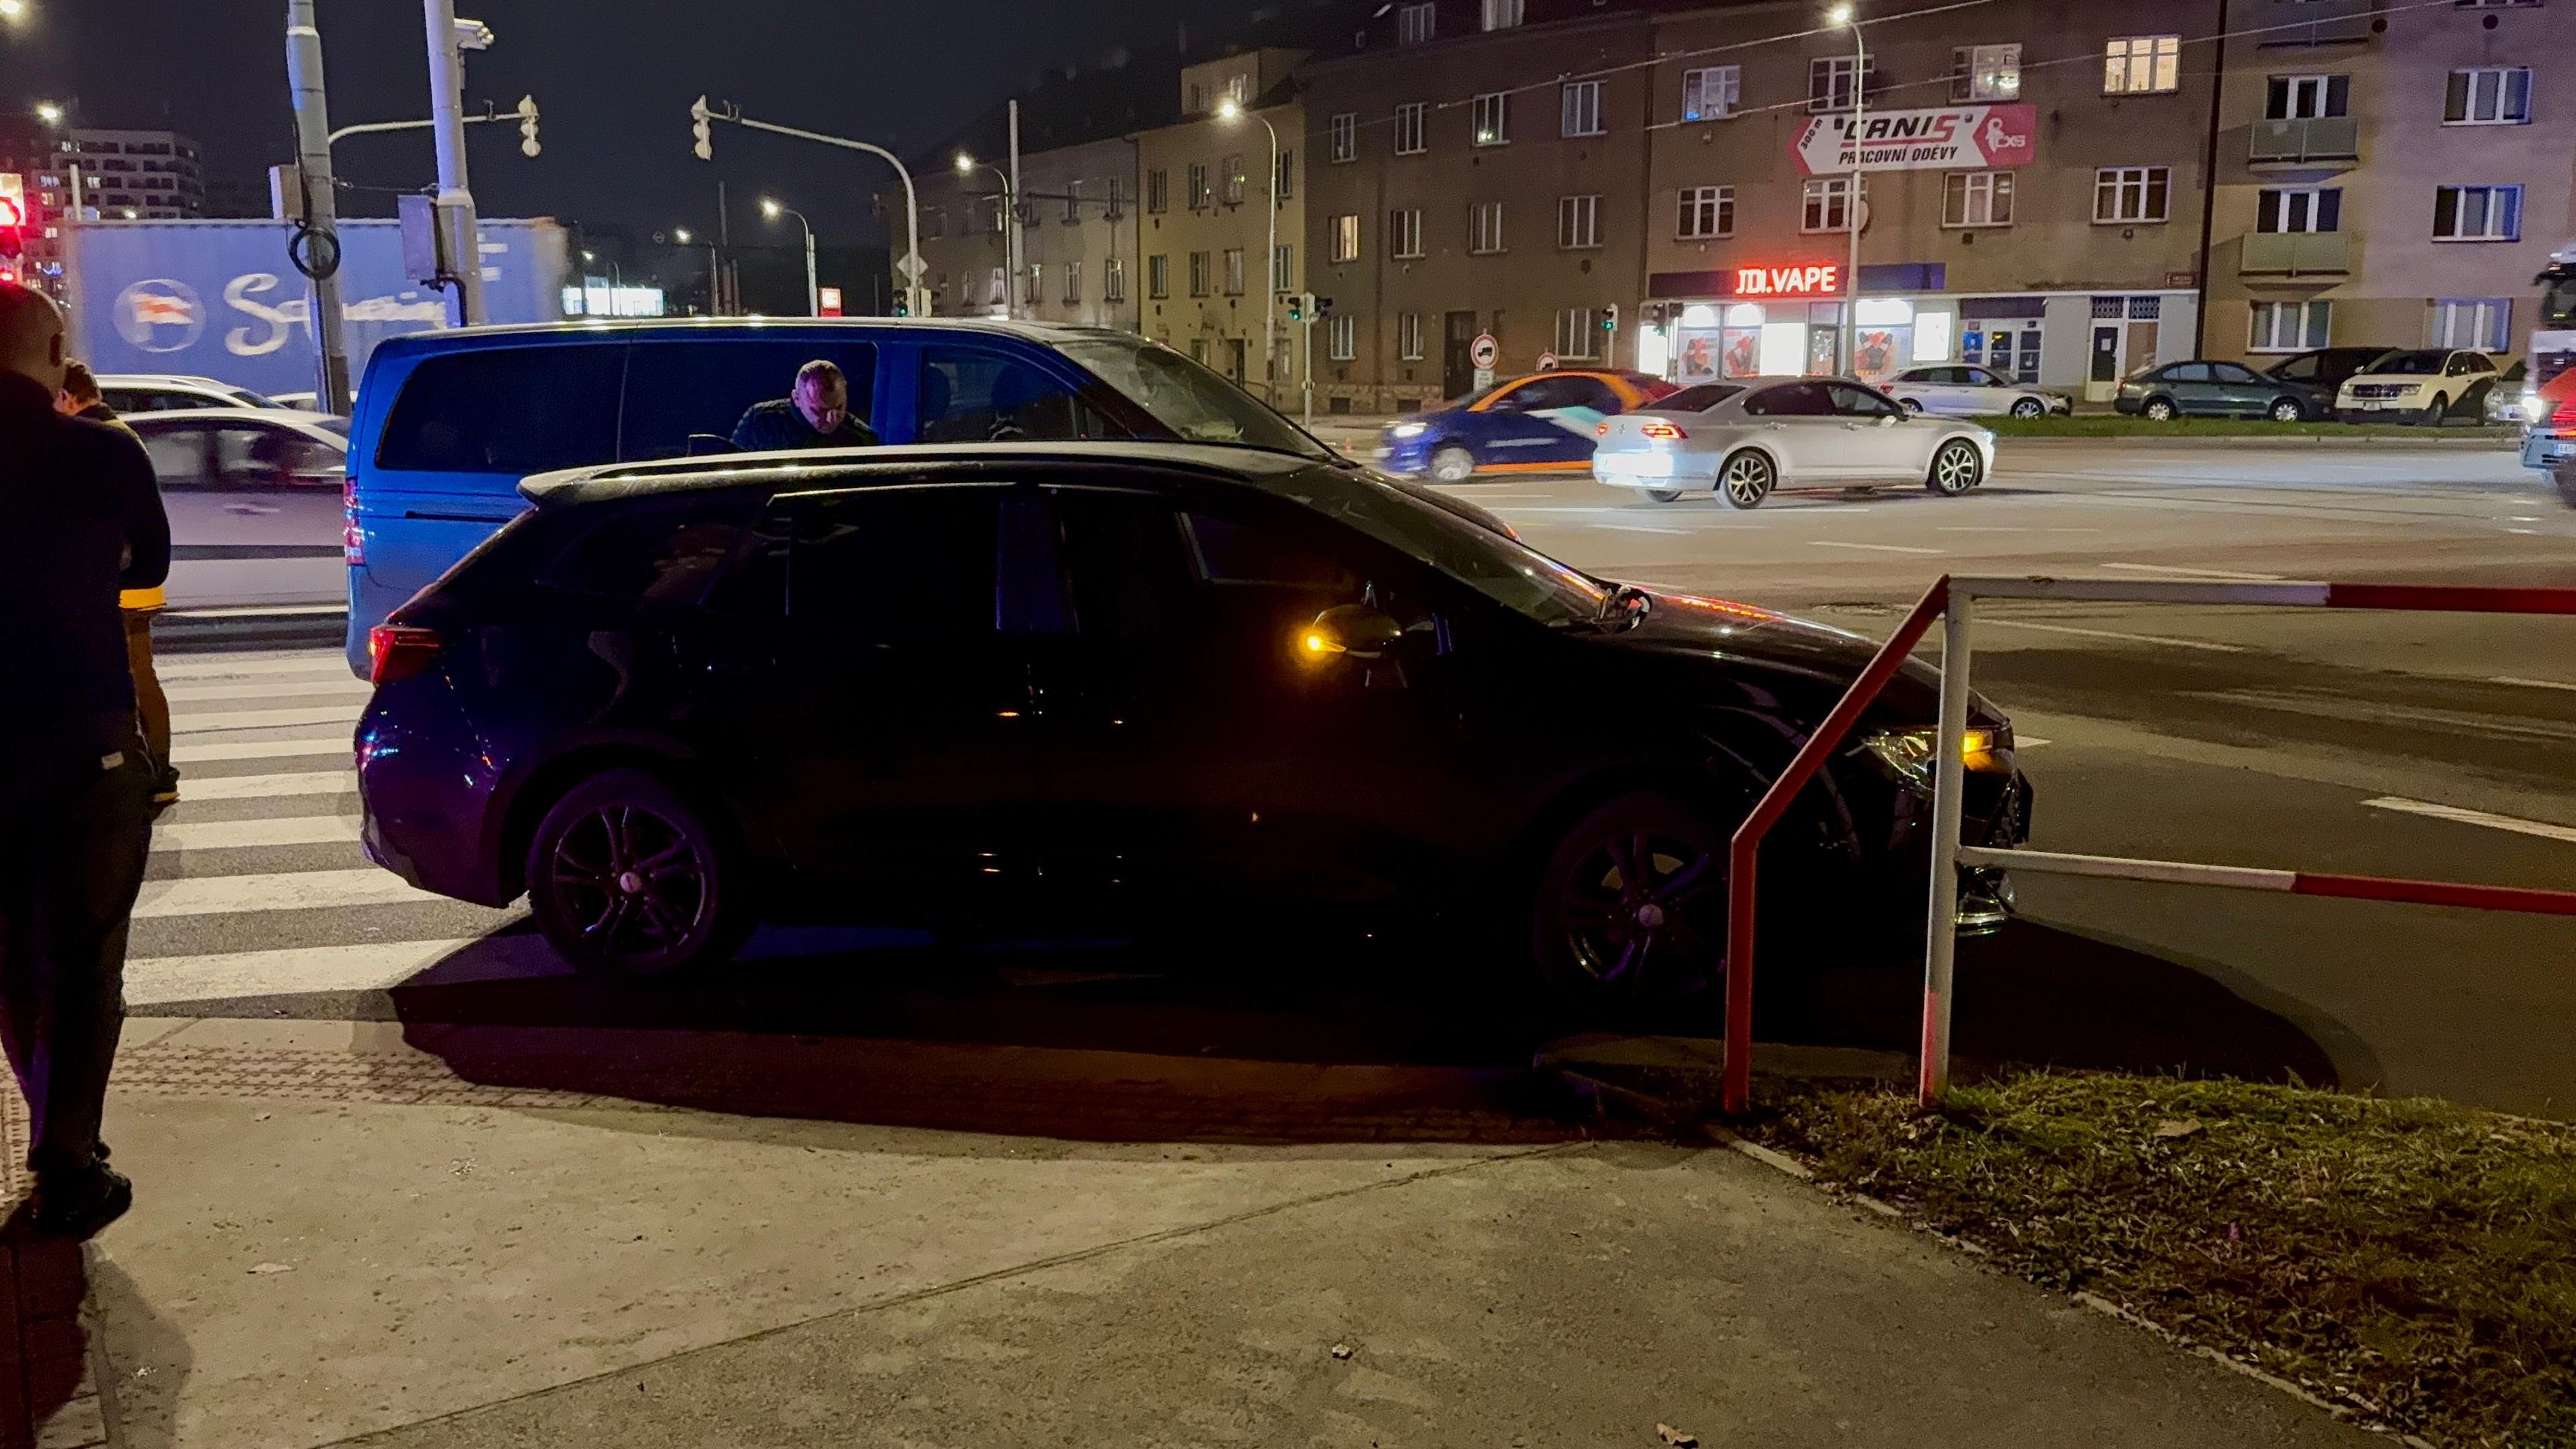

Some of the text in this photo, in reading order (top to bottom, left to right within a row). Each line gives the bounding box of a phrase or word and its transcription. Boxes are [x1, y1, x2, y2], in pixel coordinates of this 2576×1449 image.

[1800, 118, 1823, 149] 300 m
[1844, 114, 1960, 142] CANIS
